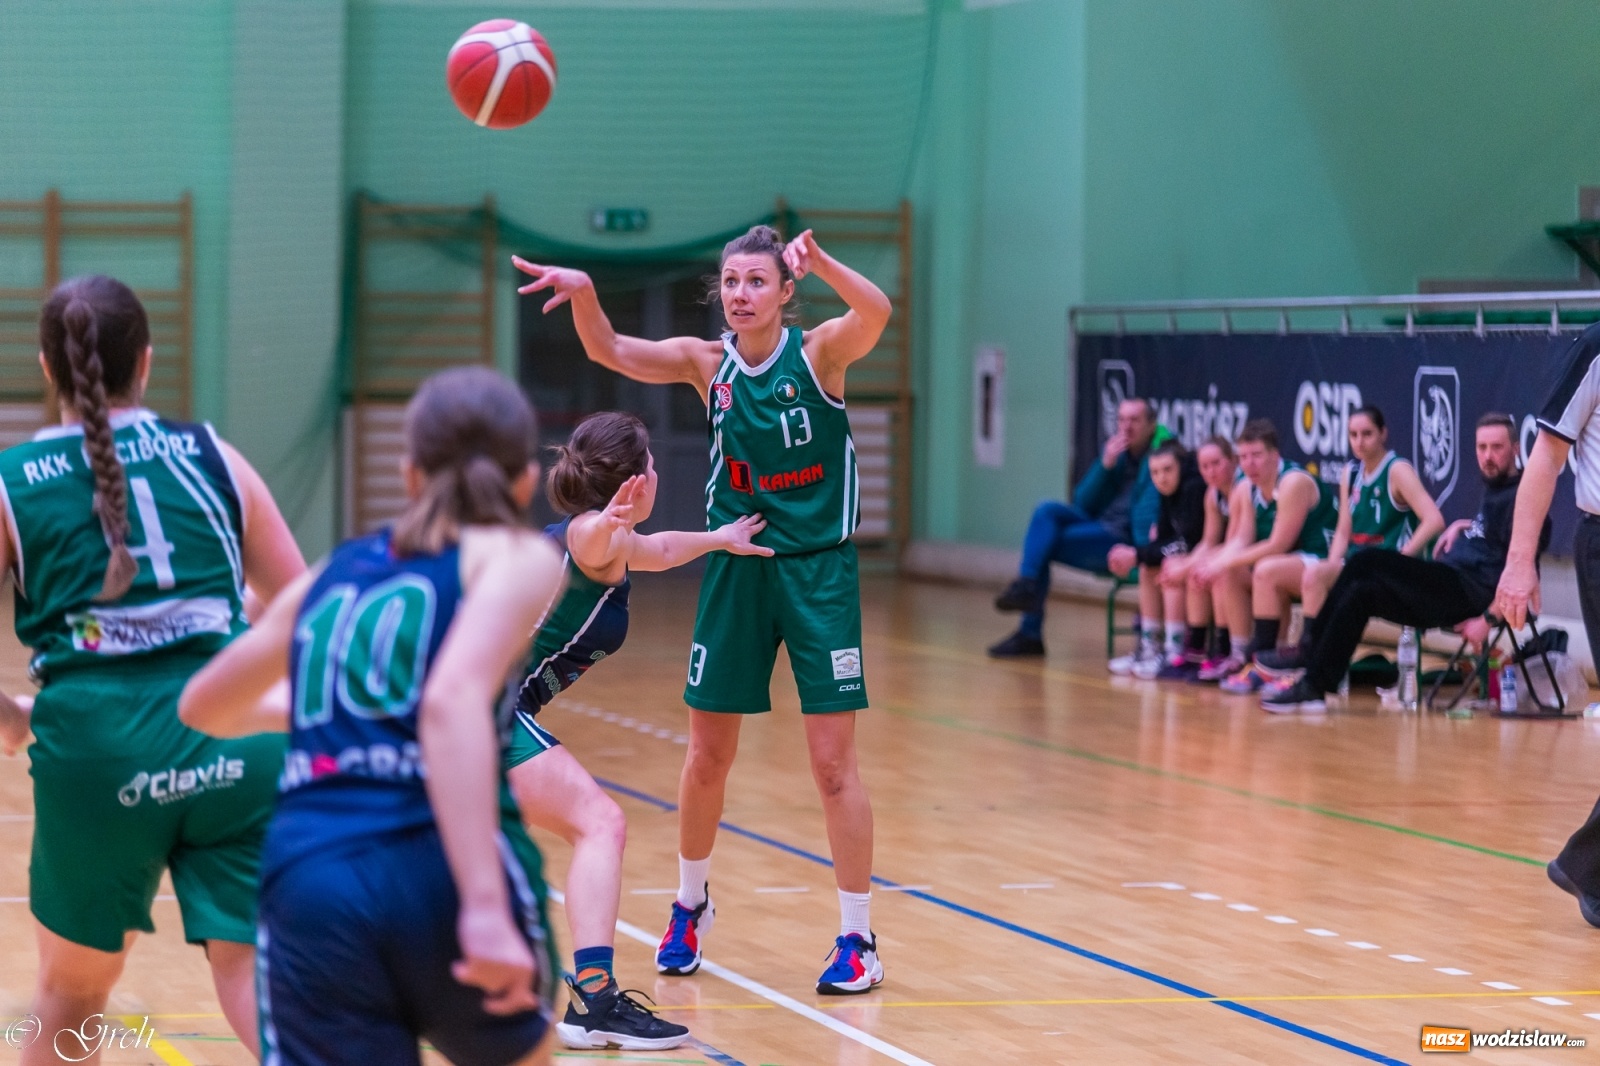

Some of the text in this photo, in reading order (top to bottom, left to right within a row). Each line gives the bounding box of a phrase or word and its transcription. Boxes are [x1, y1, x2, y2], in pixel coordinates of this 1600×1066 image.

[780, 406, 813, 449] 13
[23, 452, 73, 486] RKK
[758, 463, 824, 492] KAMAN
[95, 477, 176, 590] 4
[296, 573, 437, 729] 10
